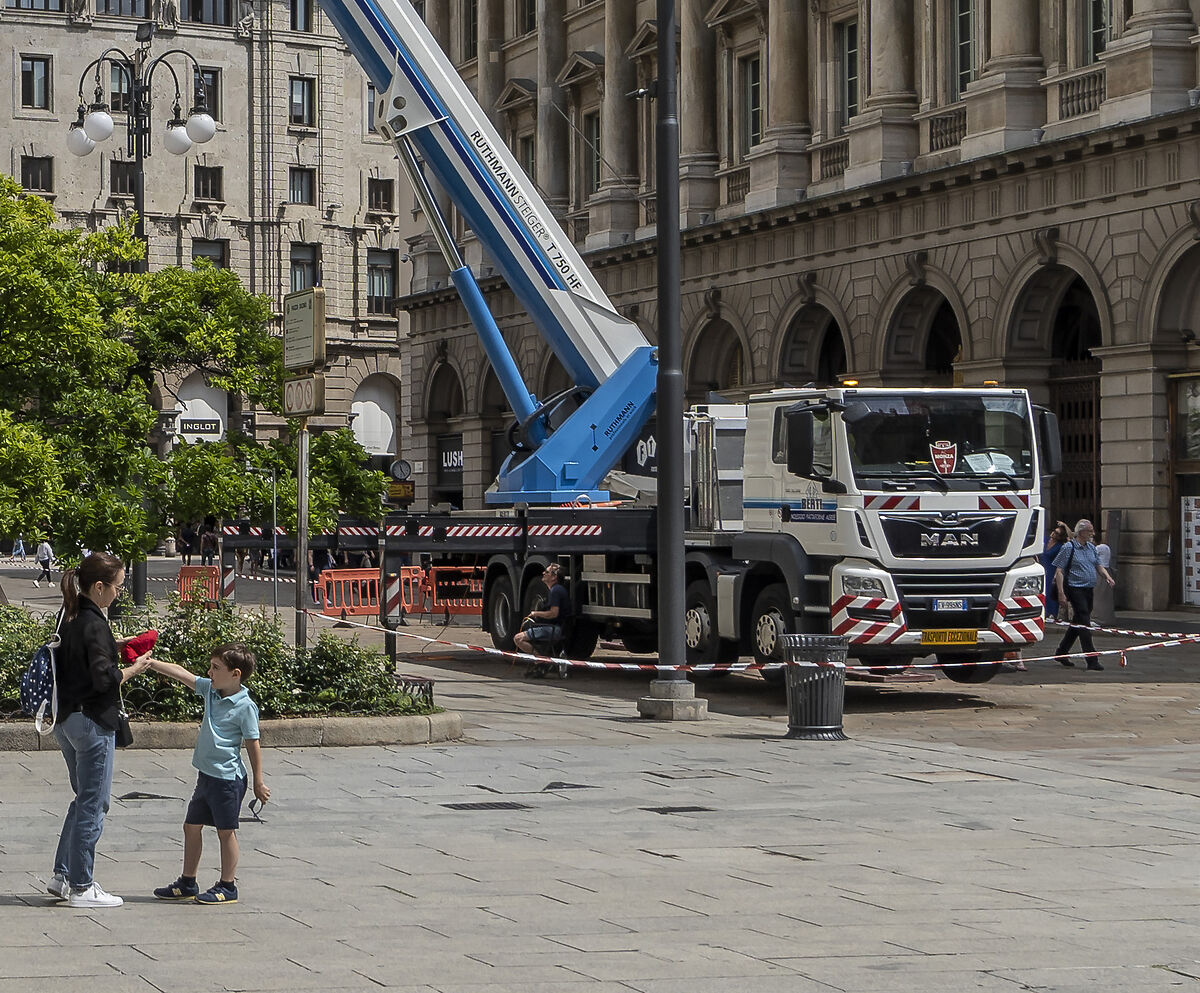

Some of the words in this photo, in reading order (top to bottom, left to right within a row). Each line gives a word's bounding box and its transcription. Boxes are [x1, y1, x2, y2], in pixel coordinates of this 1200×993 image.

[470, 130, 519, 198] RUTHMANN
[546, 242, 557, 252] T
[552, 252, 570, 274] 750
[566, 274, 582, 290] HF
[603, 400, 635, 437] RUTHMANN
[442, 450, 463, 467] LUSH
[801, 498, 823, 509] BERTI
[920, 533, 979, 546] MAN
